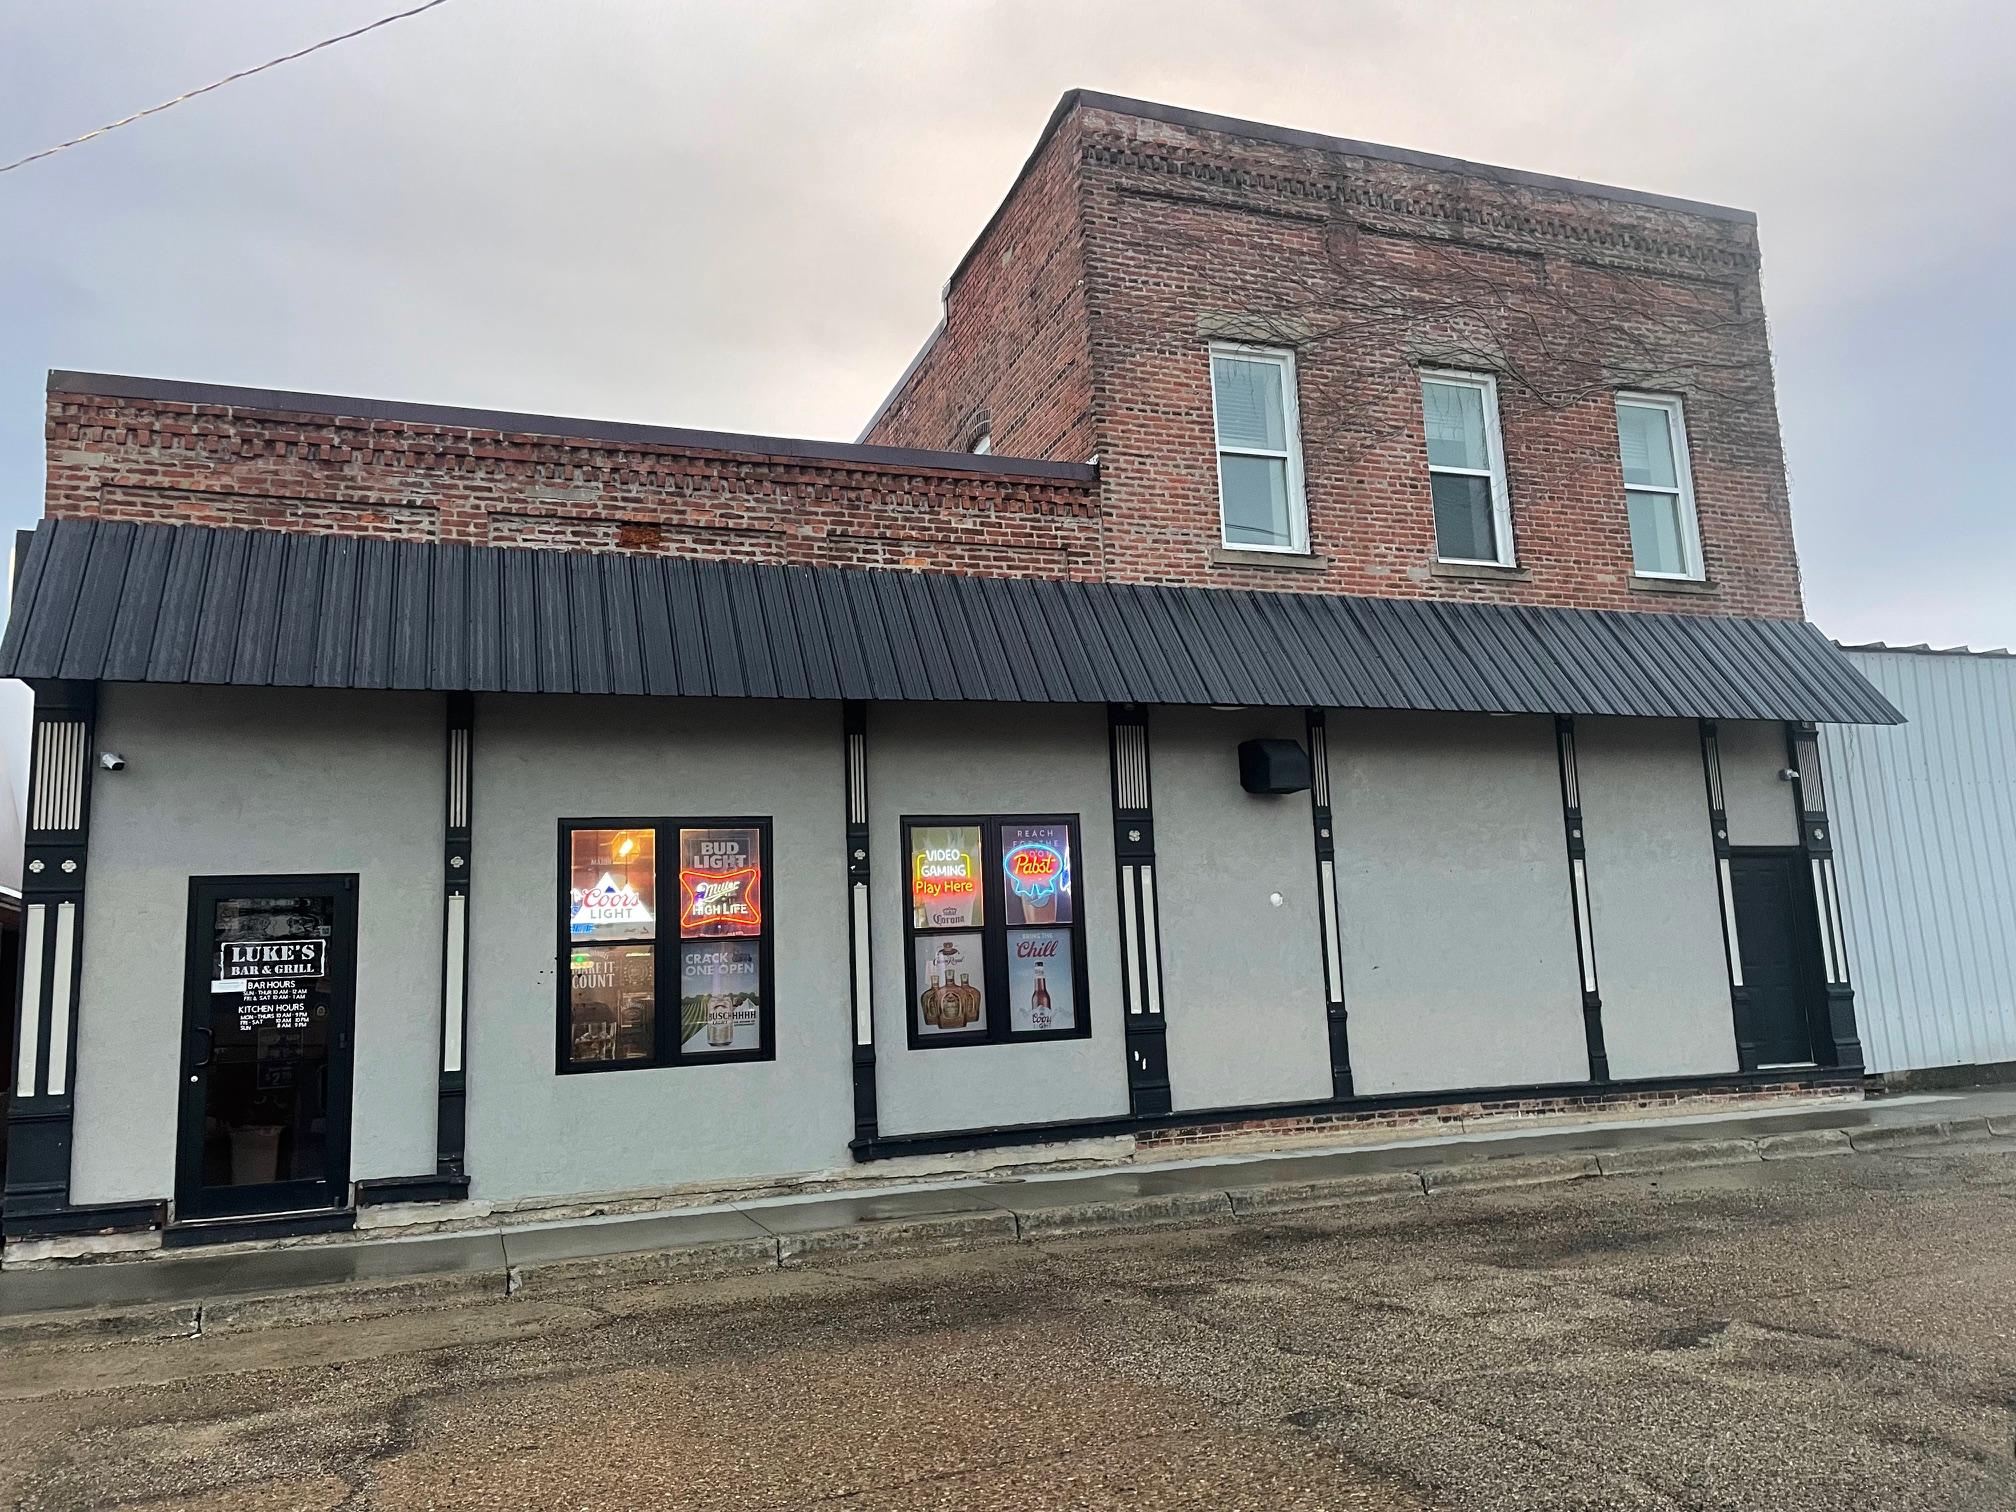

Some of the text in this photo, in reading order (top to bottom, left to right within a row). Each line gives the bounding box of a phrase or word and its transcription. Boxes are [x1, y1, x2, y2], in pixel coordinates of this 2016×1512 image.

[1017, 830, 1053, 838] REACH
[701, 842, 739, 854] BUD
[925, 849, 960, 861] VIDEO
[694, 855, 746, 869] LIGHT
[1014, 853, 1056, 875] Pabst
[697, 881, 740, 899] Miller
[916, 881, 973, 896] Play Here
[582, 888, 639, 908] Coors
[590, 909, 632, 919] LIGHT
[692, 903, 748, 915] HIGH LIFE
[933, 914, 964, 926] Corona
[231, 944, 315, 963] LUKE'S
[1017, 940, 1058, 958] Chill
[685, 953, 728, 964] CRACK
[231, 964, 315, 976] BAR & GRILL
[604, 961, 616, 974] IT
[685, 963, 754, 976] ONE OPEN
[247, 981, 265, 990] BAR
[267, 980, 296, 989] HOURS
[571, 973, 615, 989] COUNT
[238, 1003, 305, 1014] KITCHEN HOURS
